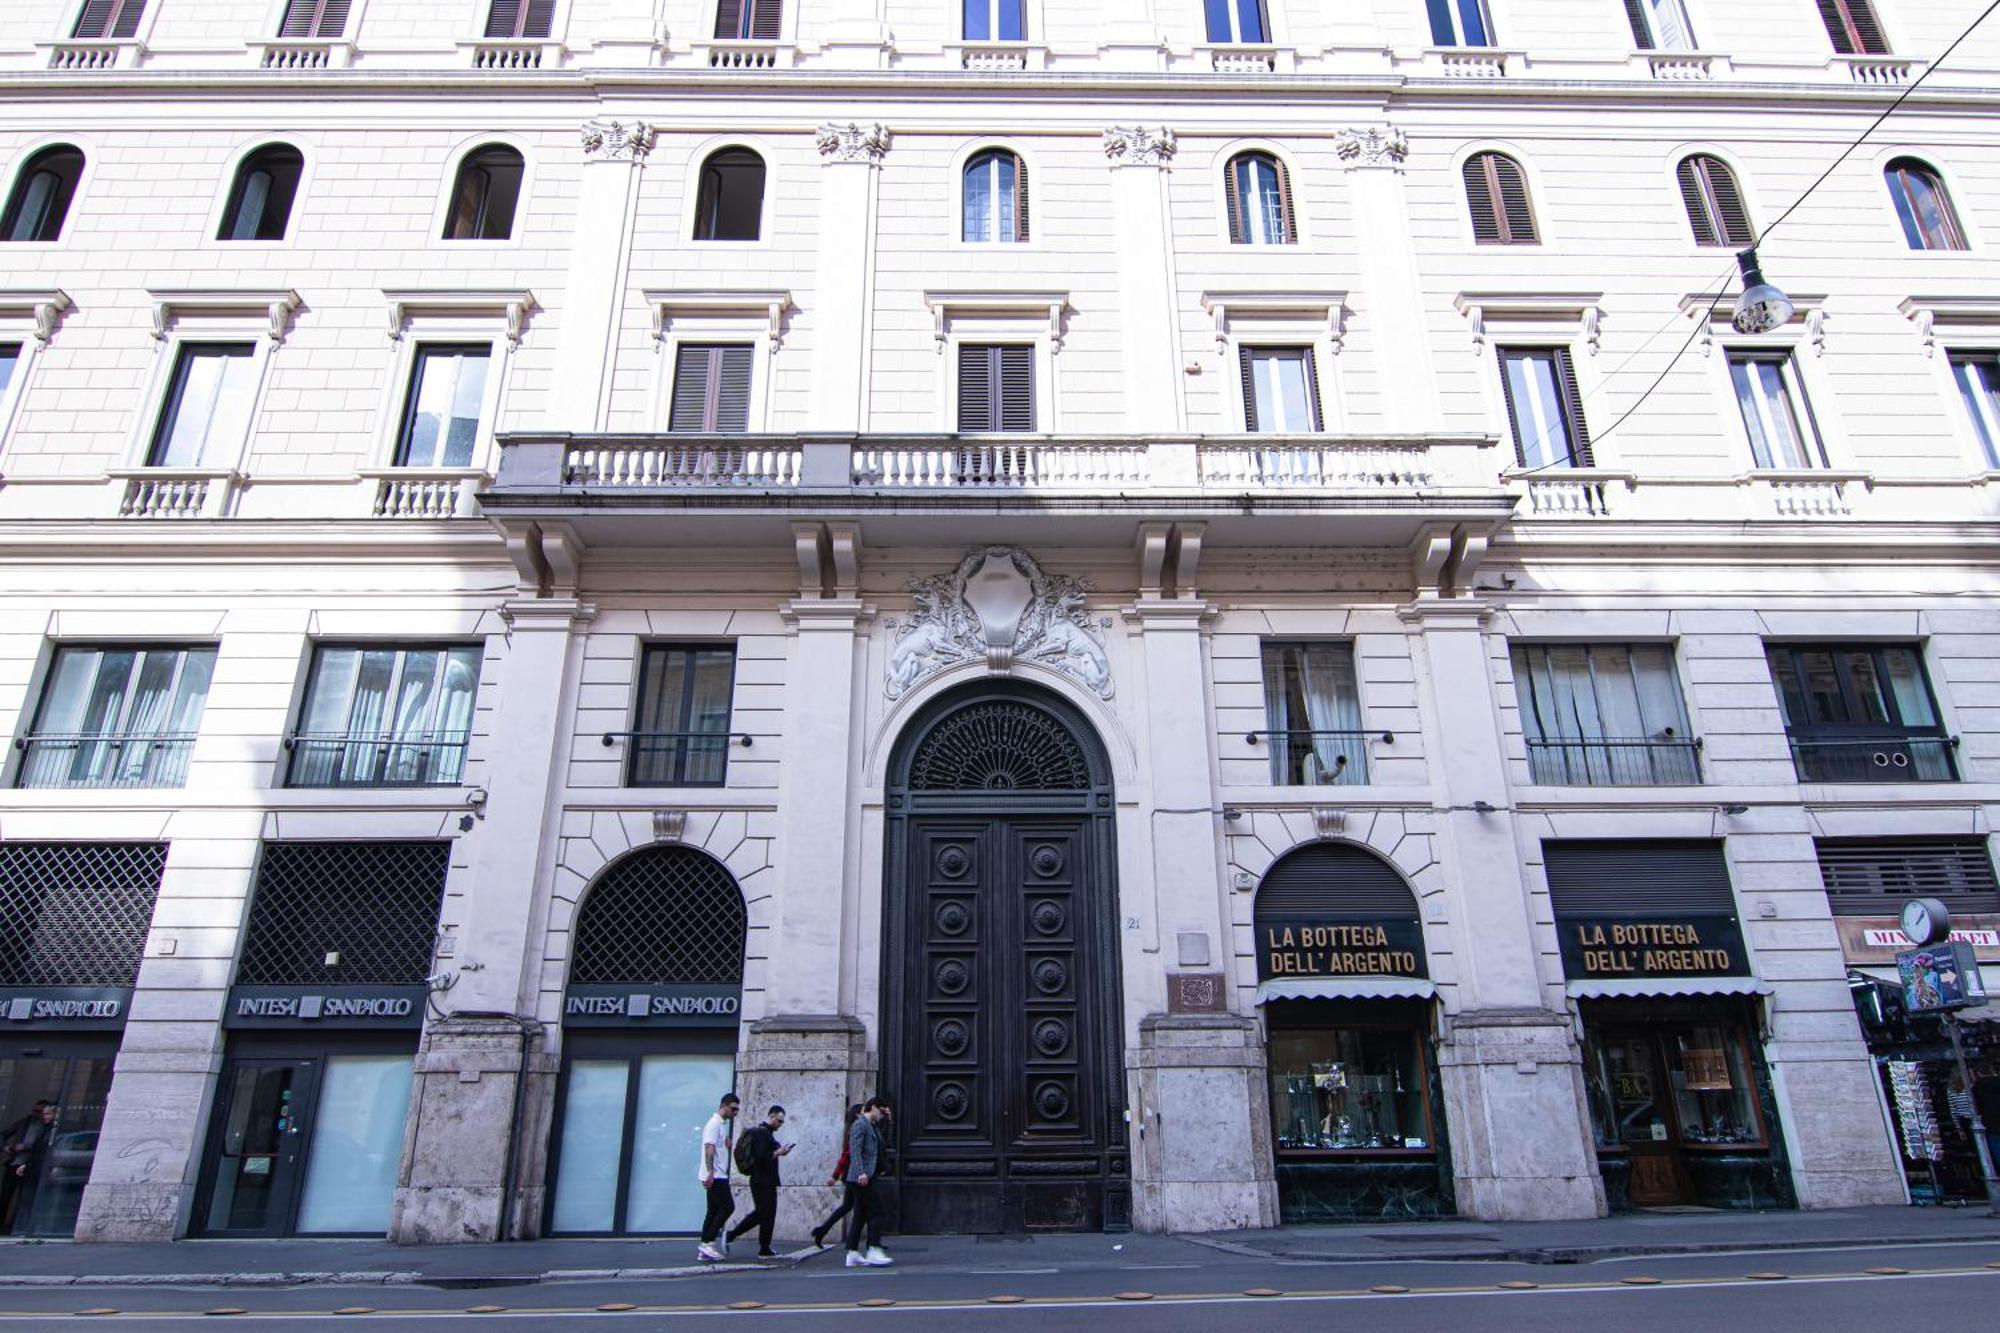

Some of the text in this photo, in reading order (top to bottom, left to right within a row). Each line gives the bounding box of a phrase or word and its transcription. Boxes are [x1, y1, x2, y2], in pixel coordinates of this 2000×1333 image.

[1128, 917, 1140, 929] 21
[1269, 926, 1388, 948] LA BOTTEGA
[1579, 924, 1700, 945] LA BOTTEGA
[1271, 952, 1416, 973] DELL' ARGENTO
[1584, 949, 1730, 971] DELL' ARGENTO
[34, 1000, 120, 1017] SANPAOLO
[237, 998, 413, 1016] INTESA SANPAOLO
[566, 996, 738, 1014] INTESA SANPAOLO
